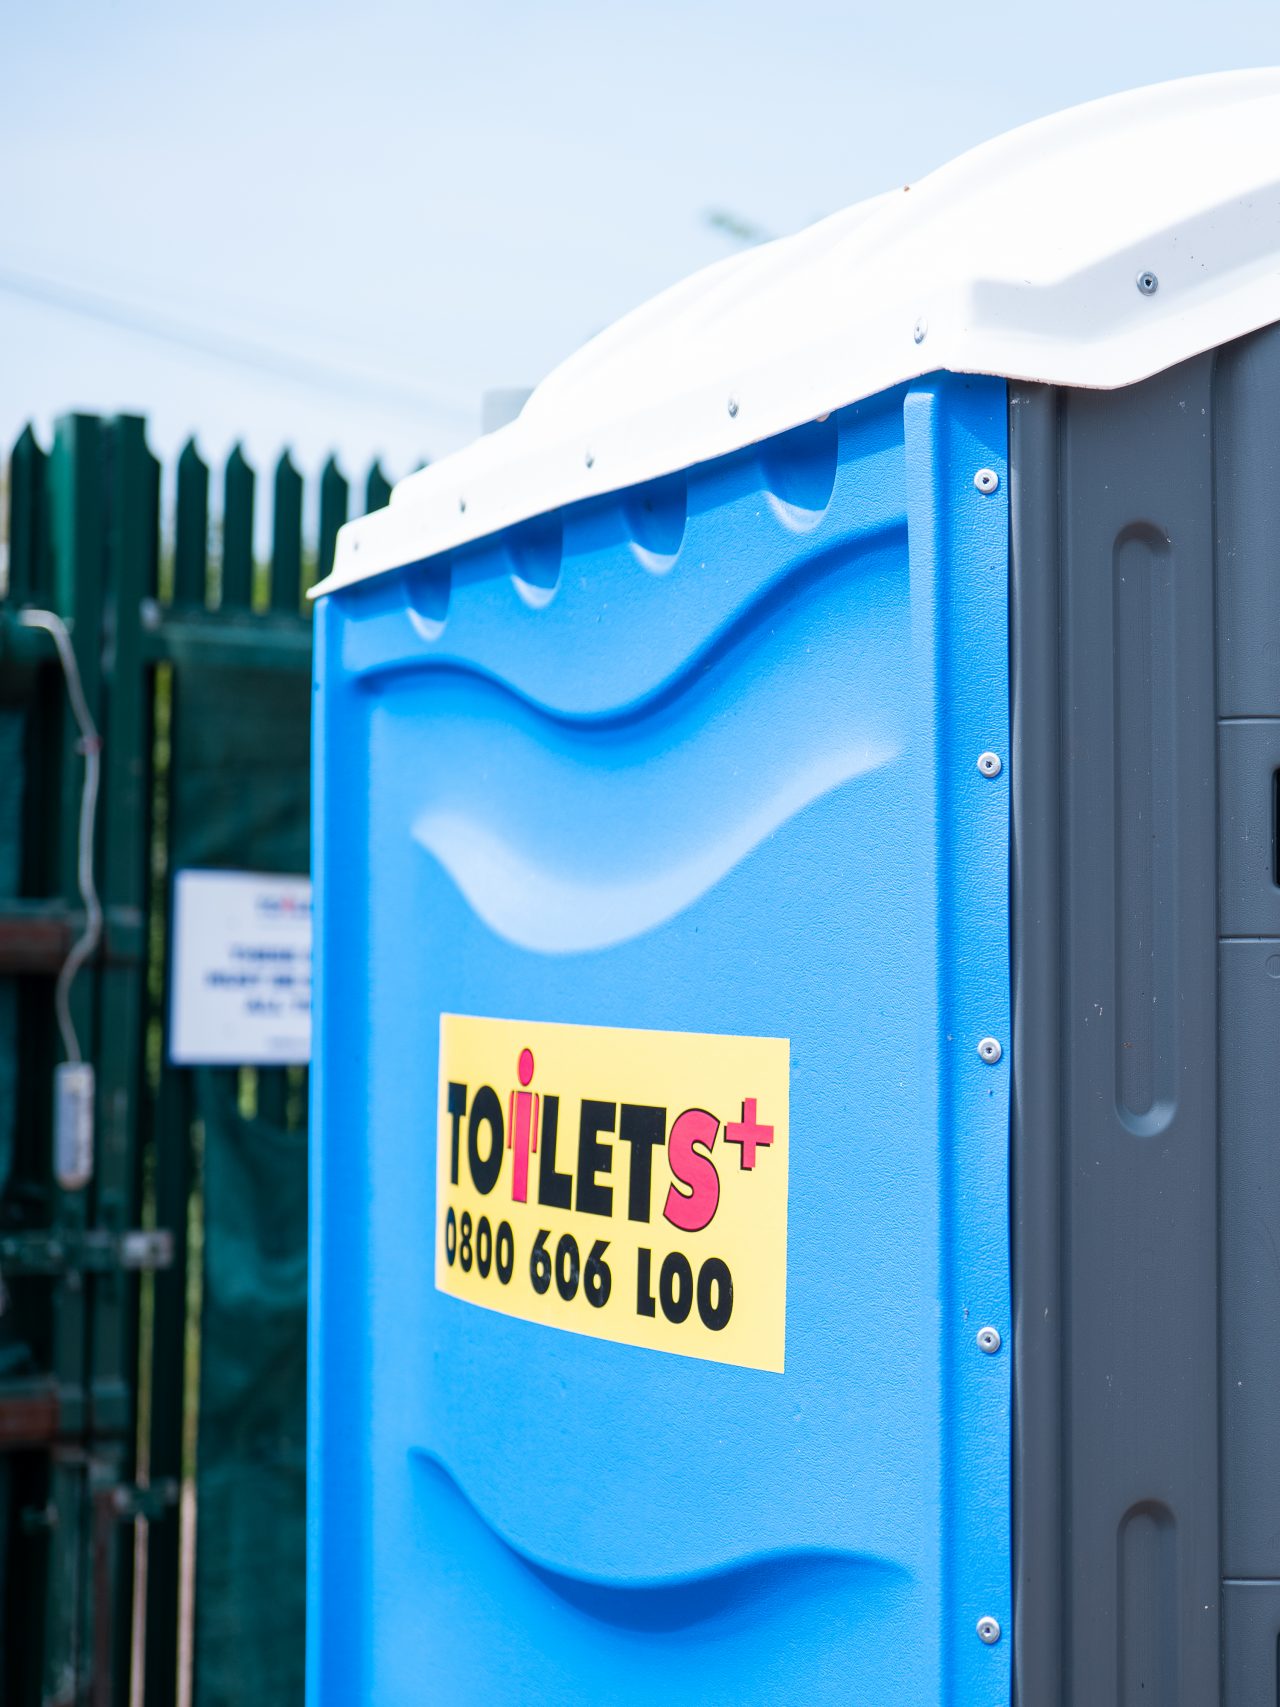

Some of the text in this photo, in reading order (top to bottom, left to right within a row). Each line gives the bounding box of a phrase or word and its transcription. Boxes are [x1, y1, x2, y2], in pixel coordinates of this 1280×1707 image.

[445, 1206, 734, 1331] 0800 606 LOO
